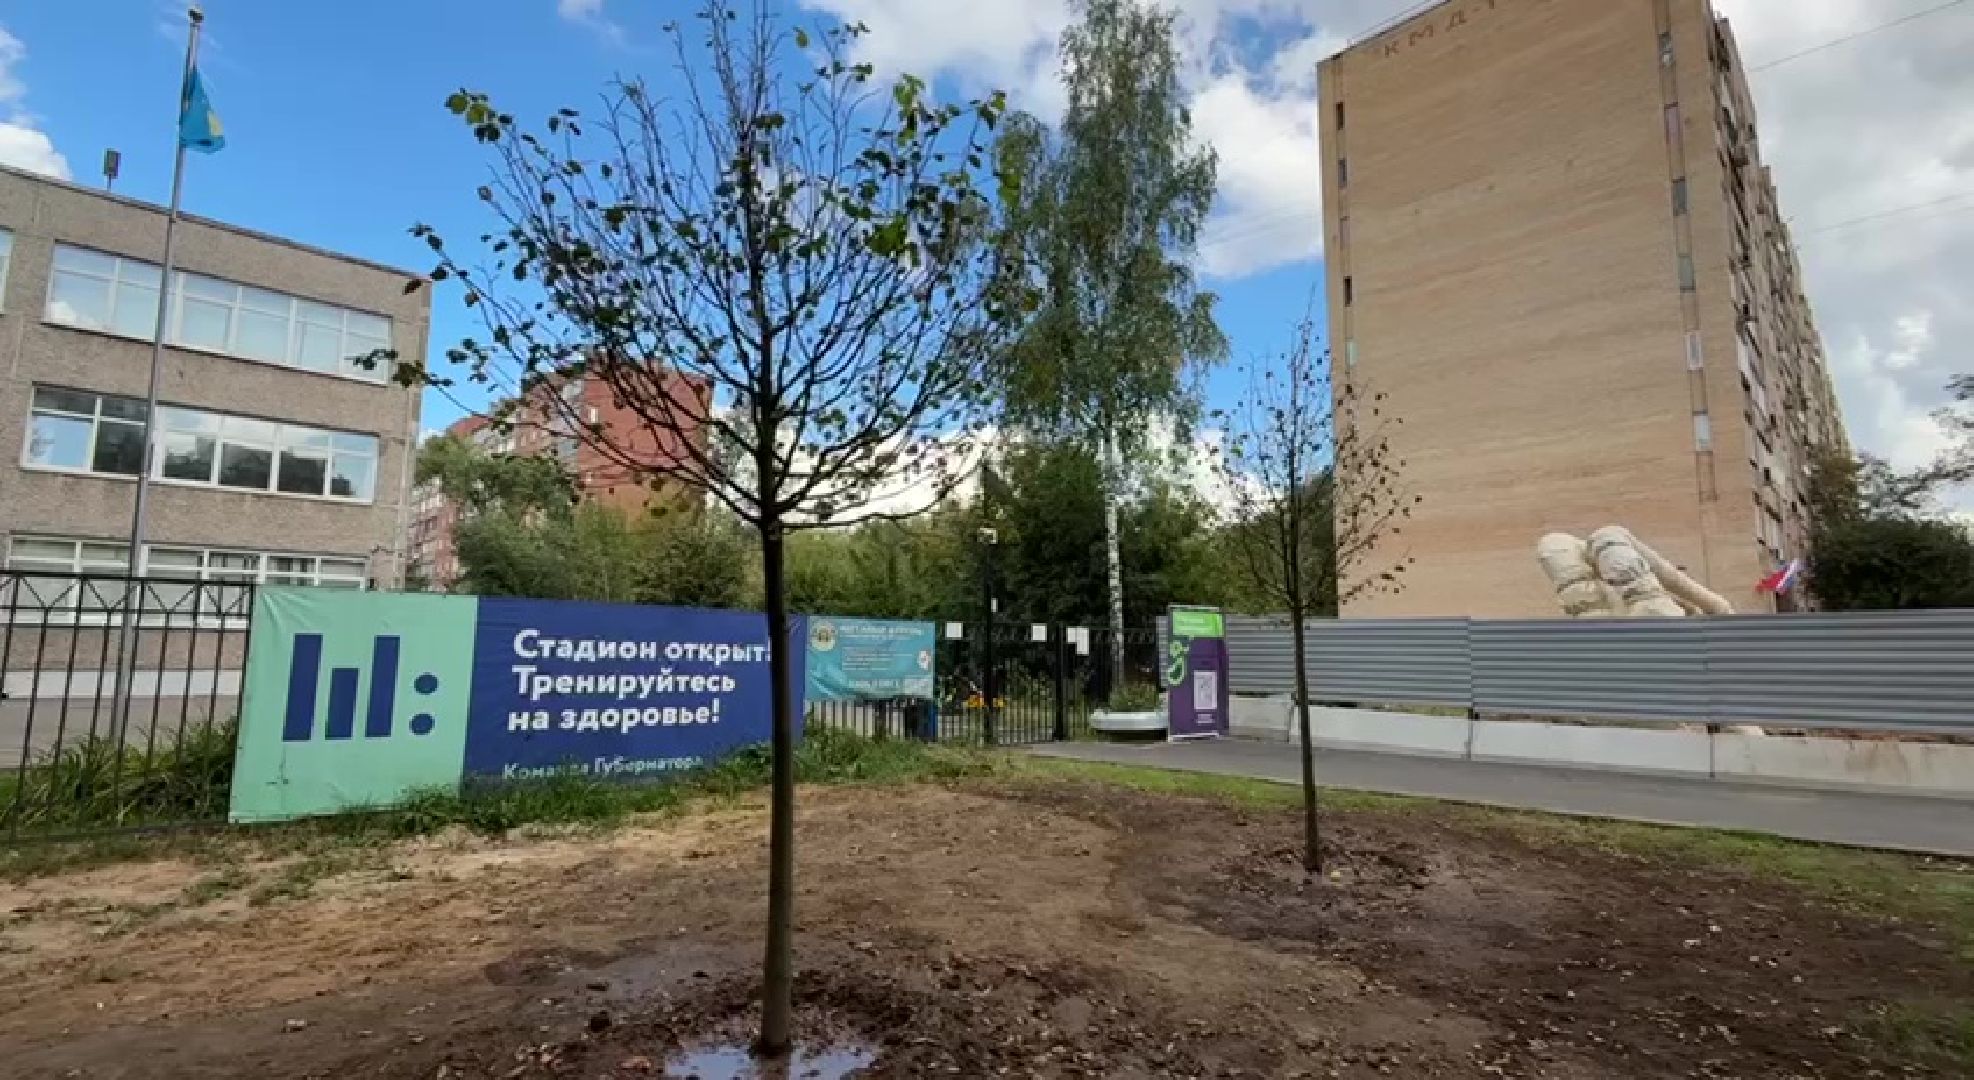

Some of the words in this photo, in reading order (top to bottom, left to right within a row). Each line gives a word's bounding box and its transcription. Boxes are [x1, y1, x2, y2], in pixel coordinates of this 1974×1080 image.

[513, 628, 656, 662] Стадион
[512, 664, 736, 701] Тренируйтесь
[507, 710, 550, 731] на
[559, 698, 719, 733] здоровье!
